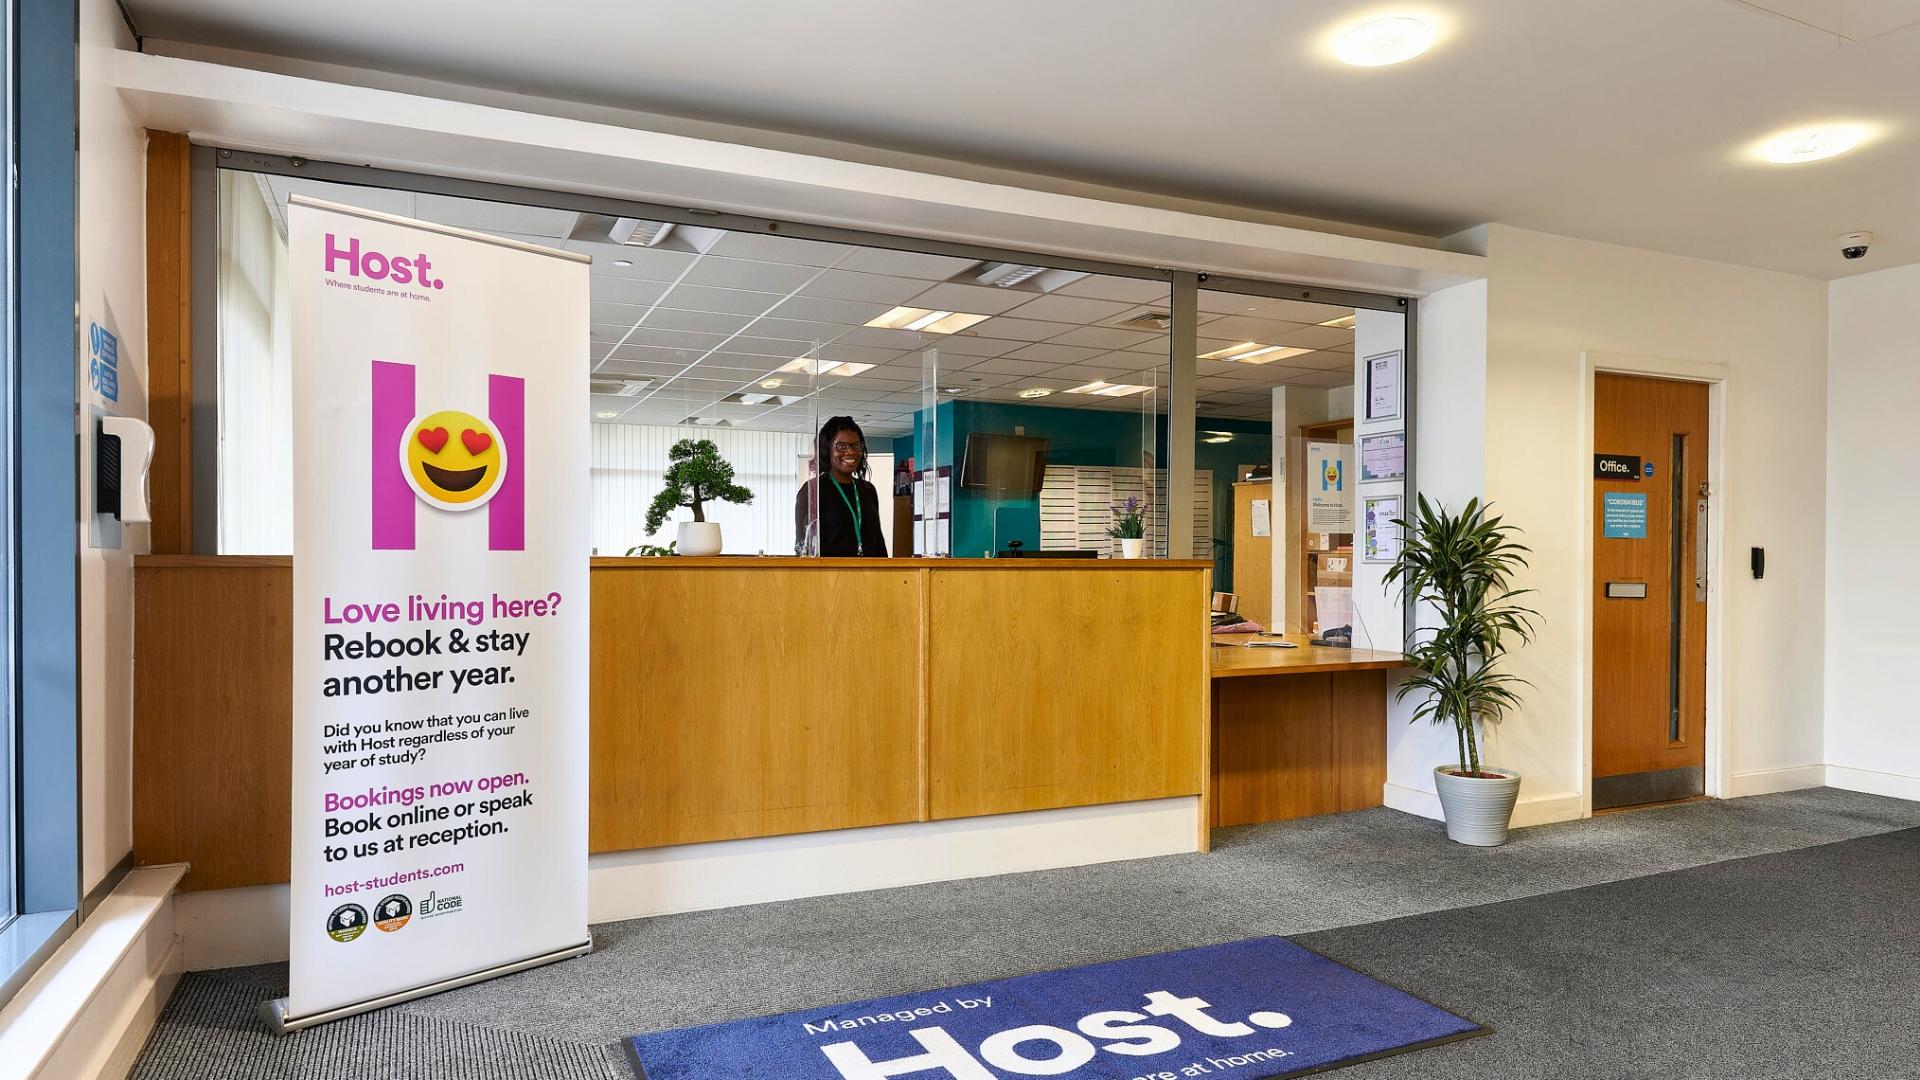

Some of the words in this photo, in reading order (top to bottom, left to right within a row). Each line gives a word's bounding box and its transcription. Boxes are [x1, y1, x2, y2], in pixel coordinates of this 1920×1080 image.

[325, 233, 444, 290] Host.
[325, 278, 351, 290] Where
[353, 284, 385, 295] students
[409, 291, 432, 302] home.
[1600, 459, 1630, 473] Office.
[324, 597, 400, 624] Love
[408, 594, 484, 626] living
[492, 591, 562, 619] here?
[324, 629, 442, 661] Rebook
[449, 628, 471, 654] &
[475, 629, 530, 656] stay
[323, 666, 443, 697] another
[449, 666, 515, 694] year.
[324, 723, 350, 738] Did
[354, 725, 382, 739] you
[385, 719, 424, 733] know
[426, 714, 454, 728] that
[456, 712, 481, 727] you
[484, 710, 507, 722] can
[509, 707, 530, 720] live
[323, 740, 357, 755] with
[361, 736, 396, 751] Host
[399, 730, 468, 749] regardless
[470, 725, 486, 739] of
[487, 725, 515, 740] your
[323, 759, 358, 775] year
[360, 754, 376, 768] of
[378, 748, 426, 765] study?
[324, 786, 425, 812] Bookings
[429, 779, 473, 797] now
[477, 772, 530, 794] open.
[325, 812, 382, 838] Book
[387, 805, 450, 828] online
[454, 802, 476, 818] or
[479, 789, 534, 817] speak
[323, 845, 348, 863] to
[353, 842, 379, 859] us
[383, 834, 404, 854] at
[409, 820, 509, 849] reception.
[324, 862, 465, 898] host-students.com
[437, 895, 463, 903] NATIONAL
[437, 899, 463, 911] CODE
[802, 1001, 952, 1035] Managed
[956, 996, 992, 1009] by
[820, 990, 1293, 1080] Host.
[1180, 1062, 1212, 1077] at
[1205, 1048, 1294, 1070] home.
